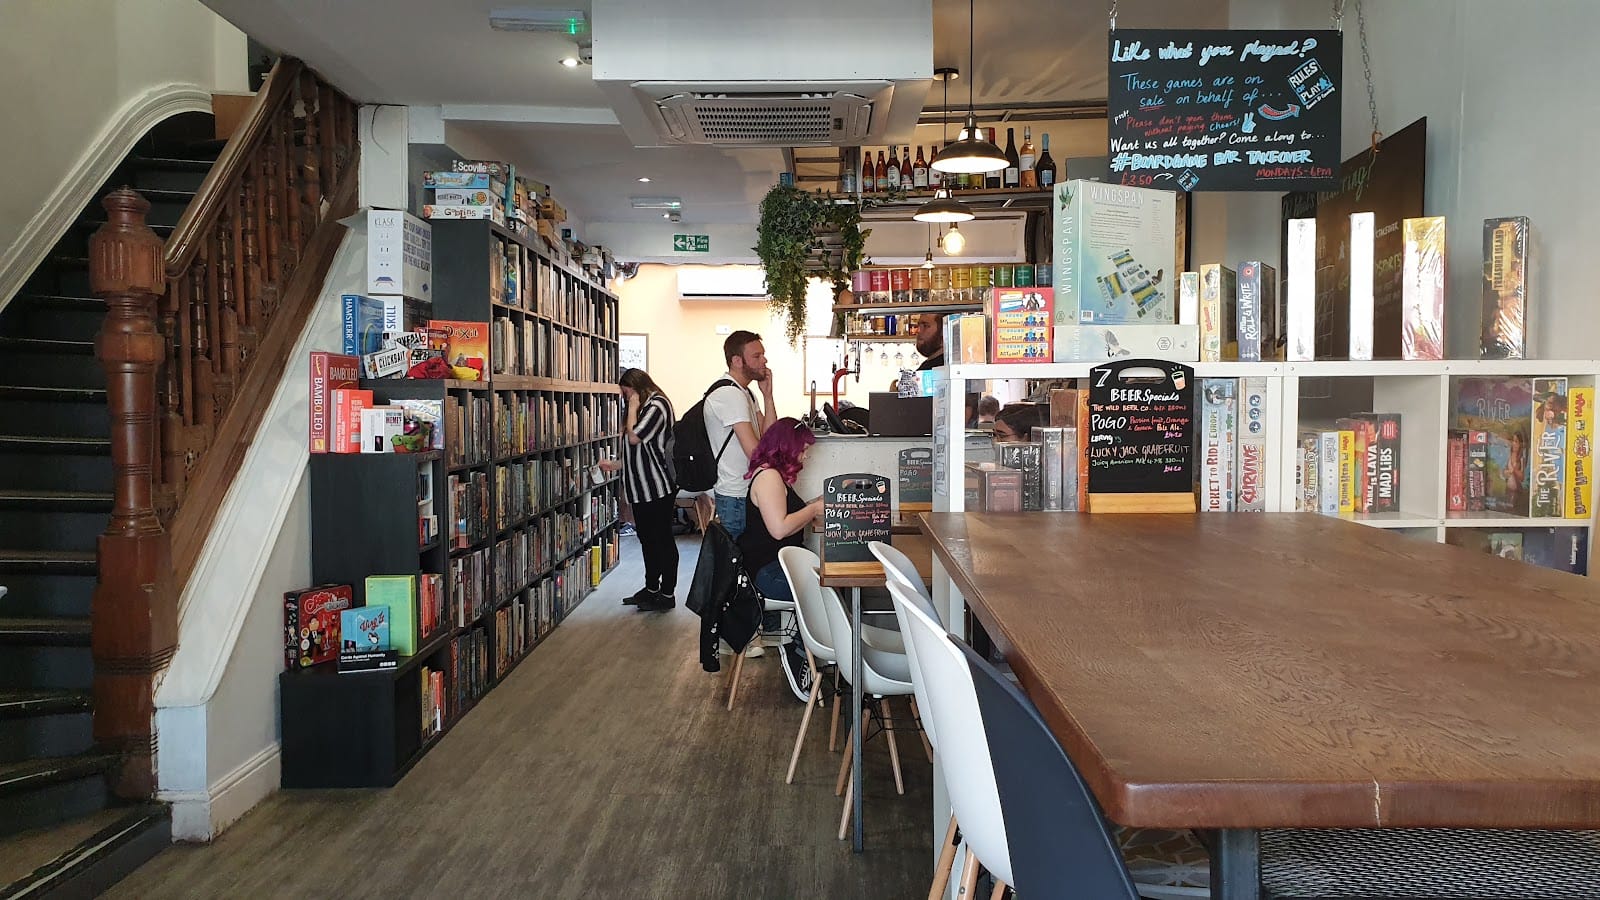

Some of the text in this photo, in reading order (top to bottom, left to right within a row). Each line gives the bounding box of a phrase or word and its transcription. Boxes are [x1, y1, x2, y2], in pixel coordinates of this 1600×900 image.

[1112, 37, 1317, 66] Like what you played?
[1120, 72, 1264, 94] These games are on
[1289, 62, 1318, 88] RULES
[1139, 95, 1165, 106] sale
[1176, 95, 1190, 105] on
[1196, 90, 1234, 108] behalf
[1300, 83, 1320, 101] PLAY
[1126, 115, 1153, 129] Please
[1144, 124, 1174, 137] without
[1177, 124, 1206, 134] paying
[1110, 138, 1139, 152] Want
[1145, 140, 1157, 149] us
[1163, 138, 1177, 148] all
[1182, 132, 1225, 150] together?
[1229, 133, 1258, 144] Come
[1264, 132, 1295, 144] along
[458, 161, 487, 173] Scoville
[1110, 150, 1313, 171] #BOARDGAME BAR TAKEOVER
[1090, 186, 1144, 204] WINGSPAN
[375, 218, 394, 226] KLASK
[1495, 230, 1503, 253] ISLAND
[1062, 216, 1072, 294] WINGSPAN
[1240, 283, 1252, 308] WRITE
[386, 306, 396, 329] SKILL
[1245, 316, 1257, 340] ROLL
[379, 351, 405, 368] CLICKBAIT
[330, 367, 358, 381] BAMBOLEO
[1095, 368, 1112, 387] 7
[314, 377, 323, 430] BAMBOLEO
[1111, 388, 1180, 404] BEER Specials
[1092, 414, 1126, 431] POGO
[1091, 445, 1190, 461] LUCKY JACK GRAPEFRUIT
[1207, 410, 1220, 512] ICKET TO RIDE EUROPE
[1367, 445, 1377, 476] LAVA
[1242, 445, 1258, 504] SURVIVE
[1537, 432, 1560, 507] THE RIVER
[828, 479, 835, 493] 6
[1380, 473, 1391, 497] MAD
[837, 493, 883, 503] BEER Specials
[825, 509, 850, 519] POGO
